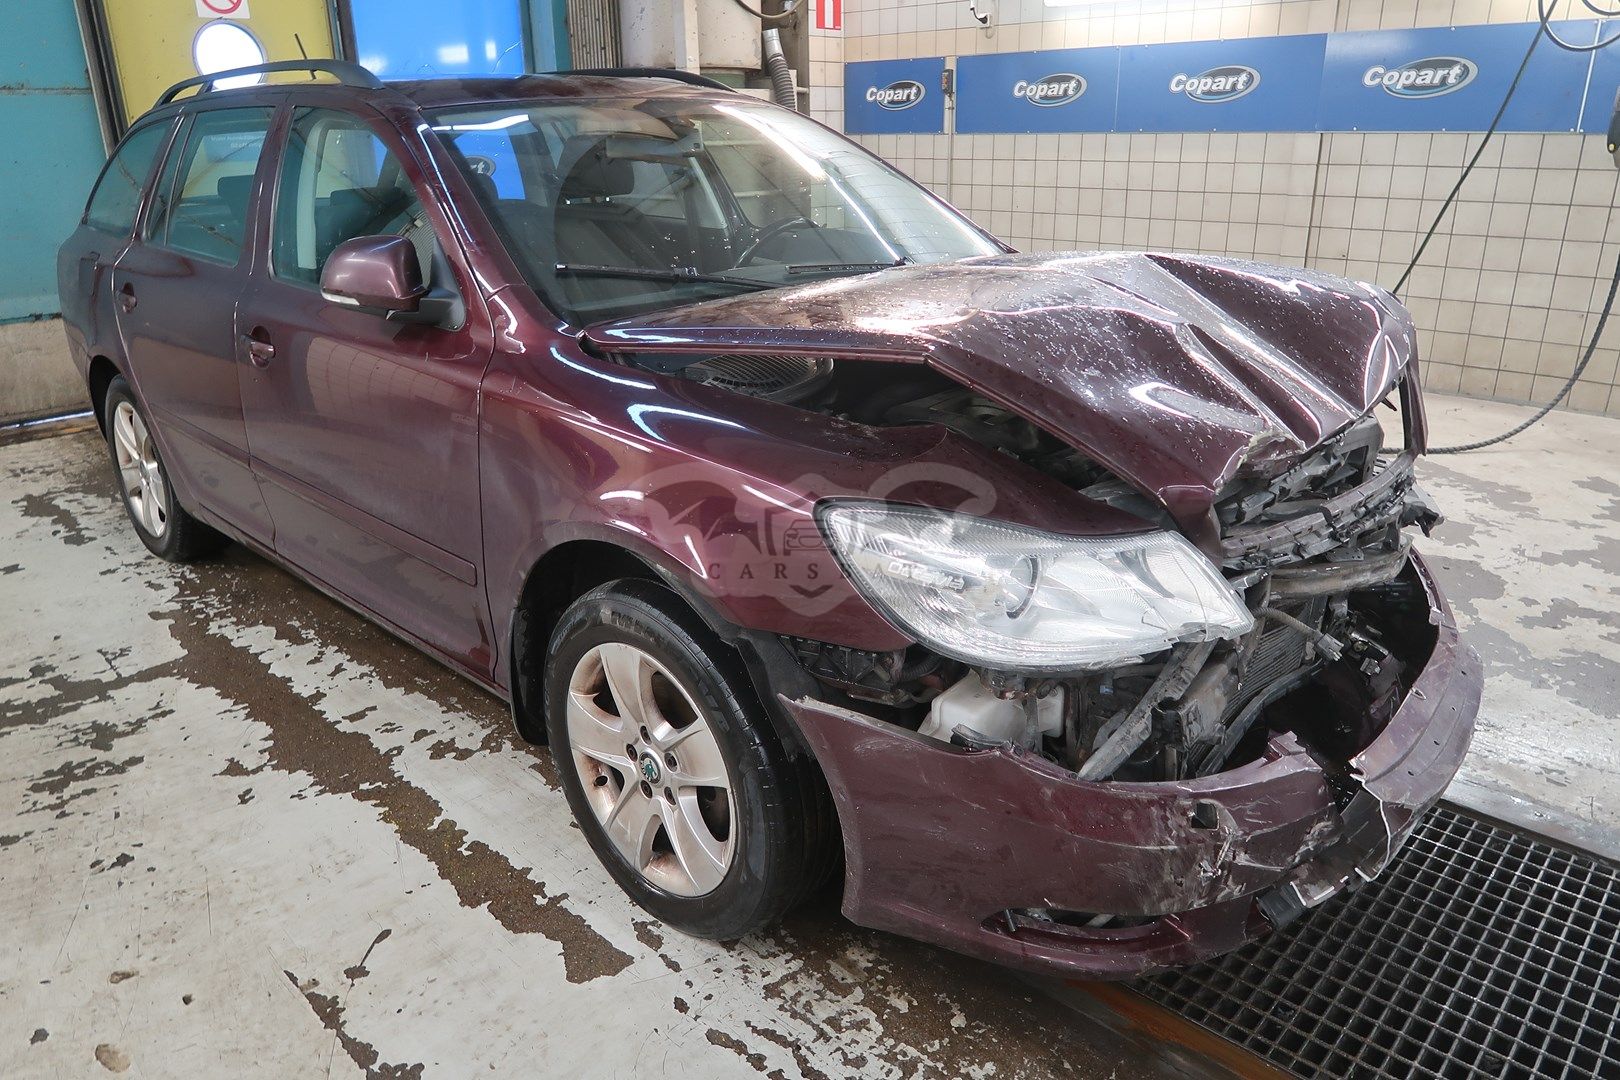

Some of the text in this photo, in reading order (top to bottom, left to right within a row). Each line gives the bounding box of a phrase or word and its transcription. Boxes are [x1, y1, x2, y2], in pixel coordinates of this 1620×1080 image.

[1170, 71, 1250, 97] Copart
[1362, 62, 1463, 90] Copart
[865, 86, 918, 104] Copart
[1012, 79, 1079, 101] Copart
